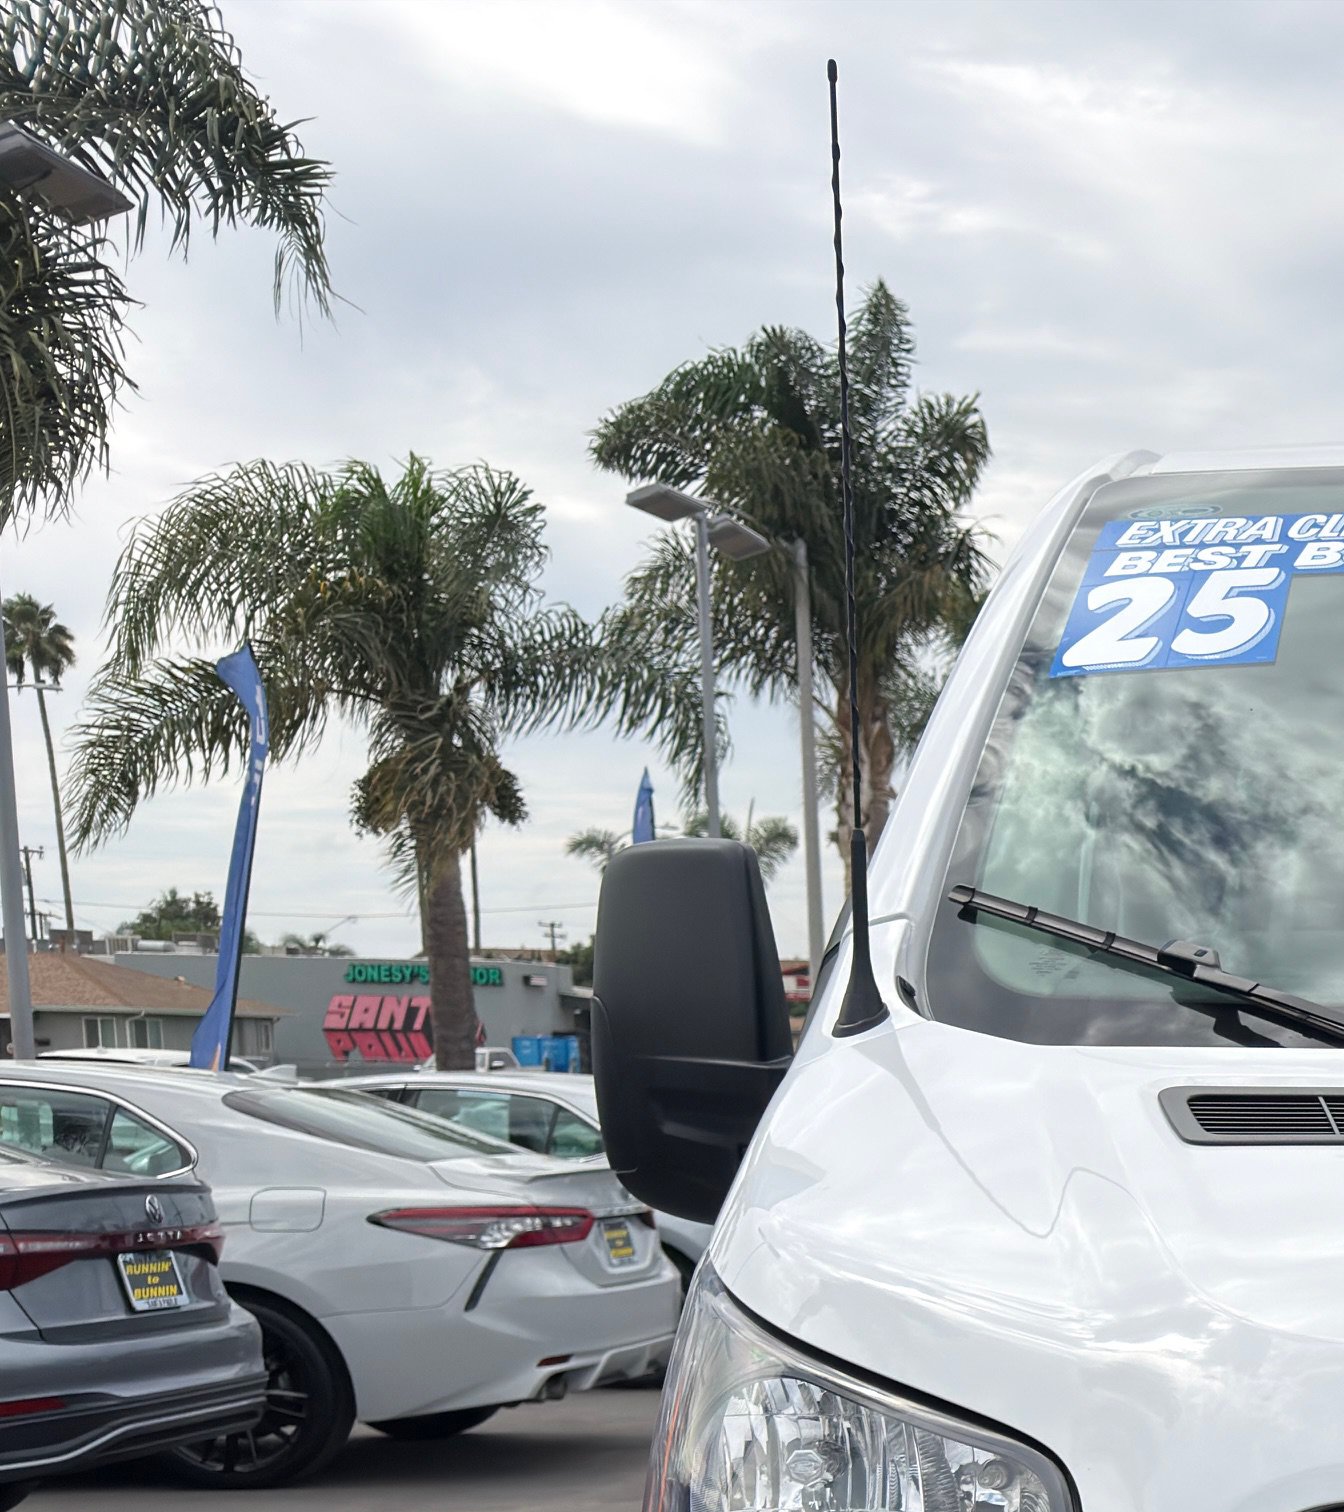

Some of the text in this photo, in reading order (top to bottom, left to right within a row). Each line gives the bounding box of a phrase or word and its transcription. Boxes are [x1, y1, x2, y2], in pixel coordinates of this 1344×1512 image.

[1115, 516, 1284, 547] EXTRA
[1104, 544, 1289, 577] BEST
[1062, 567, 1286, 671] 25
[323, 994, 432, 1031] SANT
[133, 1285, 178, 1300] BUNNIN
[147, 1275, 160, 1285] to
